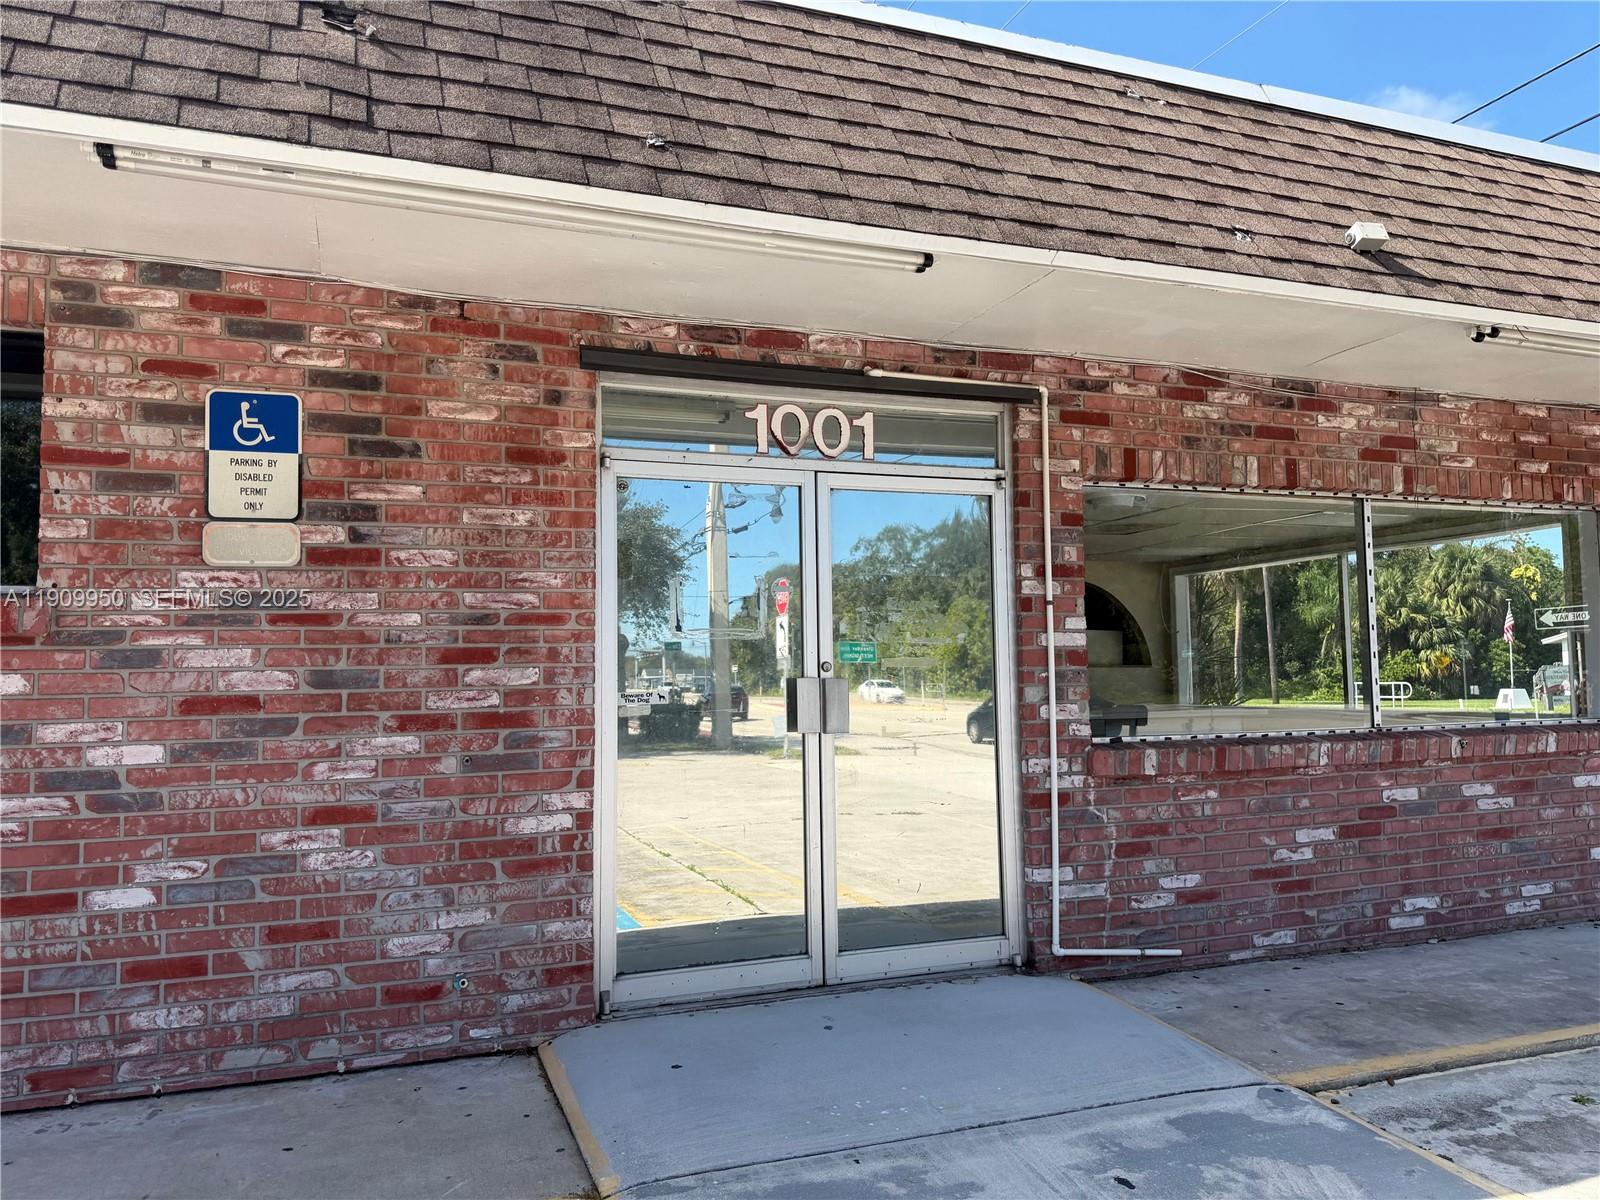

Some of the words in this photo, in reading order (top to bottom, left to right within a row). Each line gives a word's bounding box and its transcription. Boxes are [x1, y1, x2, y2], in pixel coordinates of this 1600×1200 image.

[743, 402, 875, 460] 1001
[229, 457, 264, 468] PARKING
[267, 458, 278, 468] BY
[234, 472, 274, 482] DISABLED
[239, 487, 268, 497] PERMIT
[243, 502, 264, 511] ONLY
